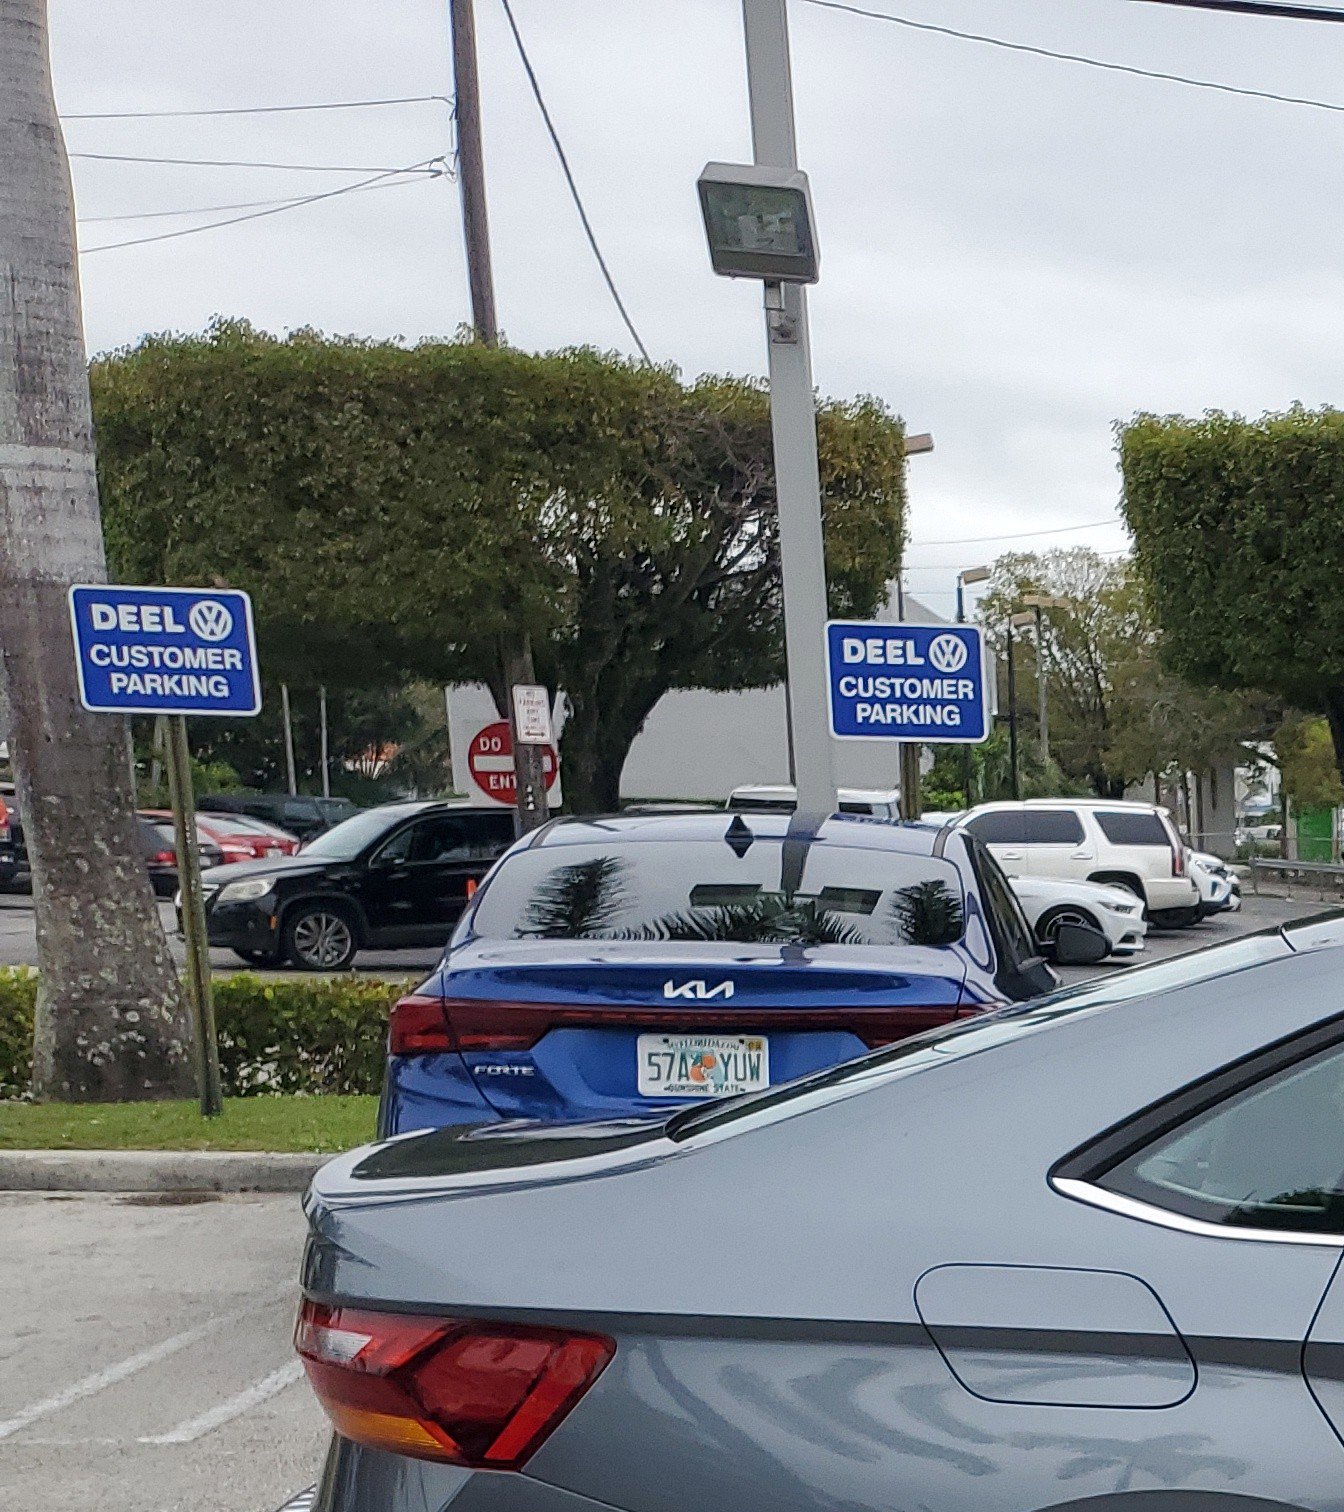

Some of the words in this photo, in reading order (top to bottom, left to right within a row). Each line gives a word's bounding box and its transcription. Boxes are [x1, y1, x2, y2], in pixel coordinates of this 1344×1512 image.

[91, 603, 185, 633] DEEL
[90, 644, 243, 670] CUSTOMER
[843, 638, 925, 665] DEEL
[111, 672, 229, 698] PARKING
[839, 676, 974, 700] CUSTOMER
[856, 703, 961, 726] PARKING
[480, 737, 502, 752] DO
[489, 774, 517, 790] ENT
[664, 979, 735, 999] KIA
[474, 1065, 535, 1077] FORTE
[648, 1052, 690, 1082] 57A
[719, 1052, 762, 1083] YUW
